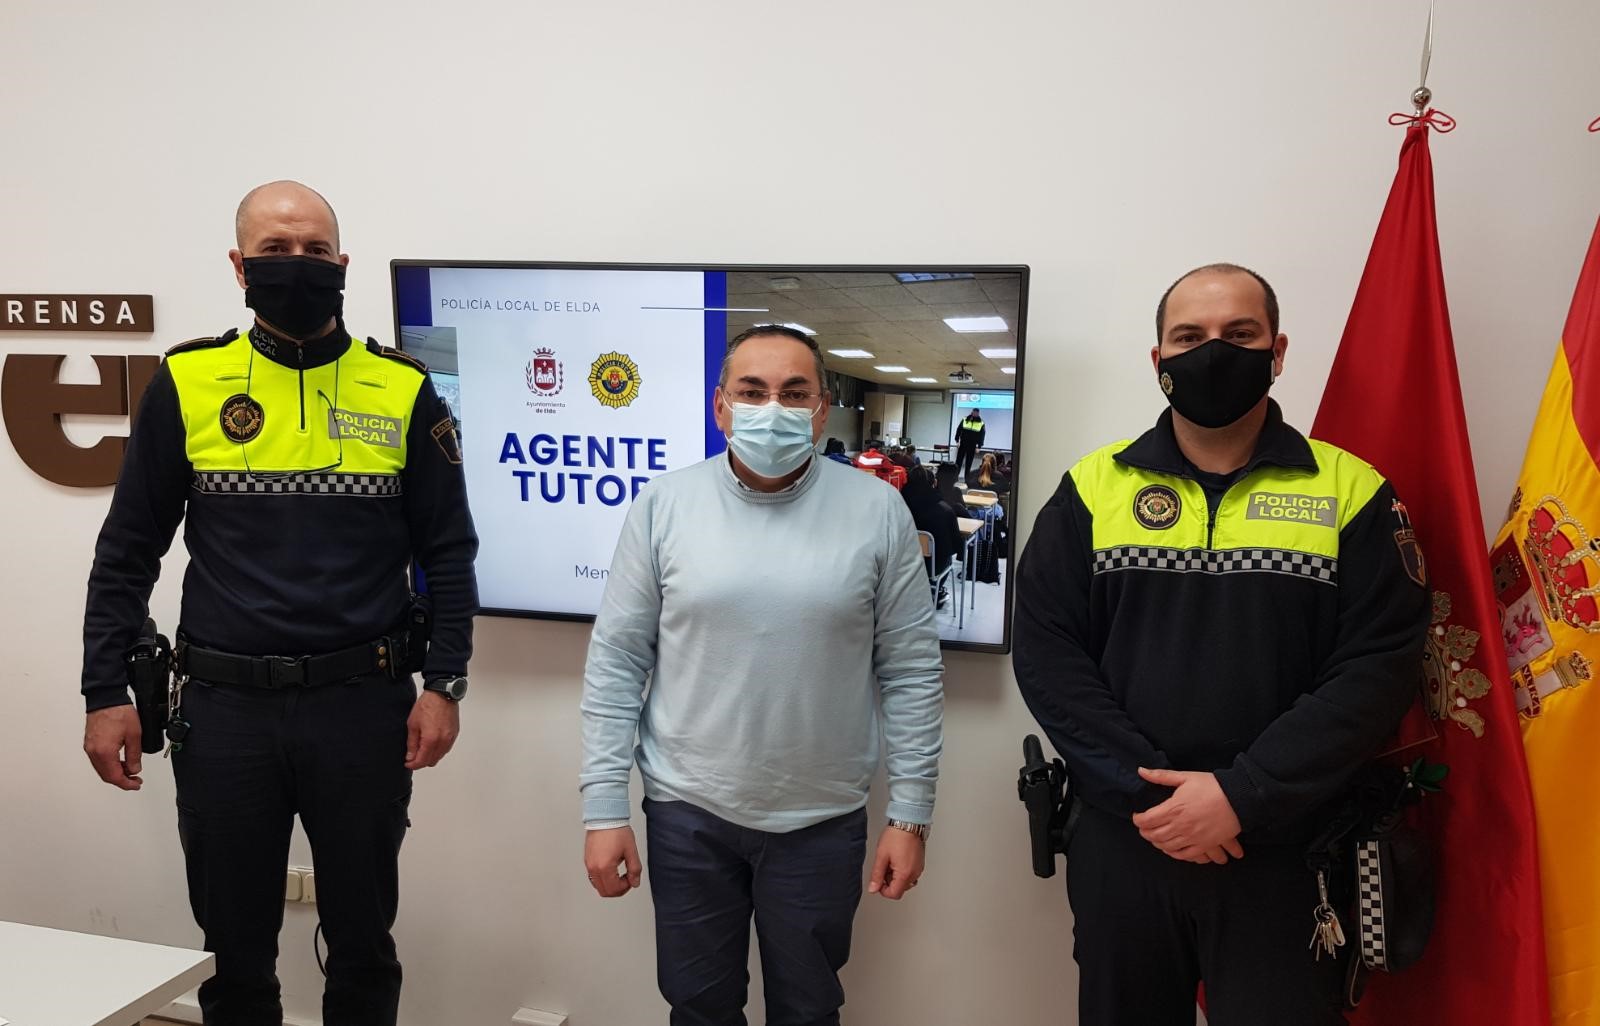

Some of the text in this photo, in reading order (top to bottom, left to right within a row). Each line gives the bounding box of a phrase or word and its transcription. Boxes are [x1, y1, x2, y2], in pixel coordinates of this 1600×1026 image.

[7, 300, 136, 325] RENSA
[441, 298, 601, 313] POLICÍA LOCAL DE ELDA
[334, 412, 397, 432] POLICIA
[340, 425, 391, 444] LOCAL
[499, 432, 667, 471] AGENTE
[1254, 494, 1331, 511] POLICIA
[1259, 506, 1322, 522] LOCAL
